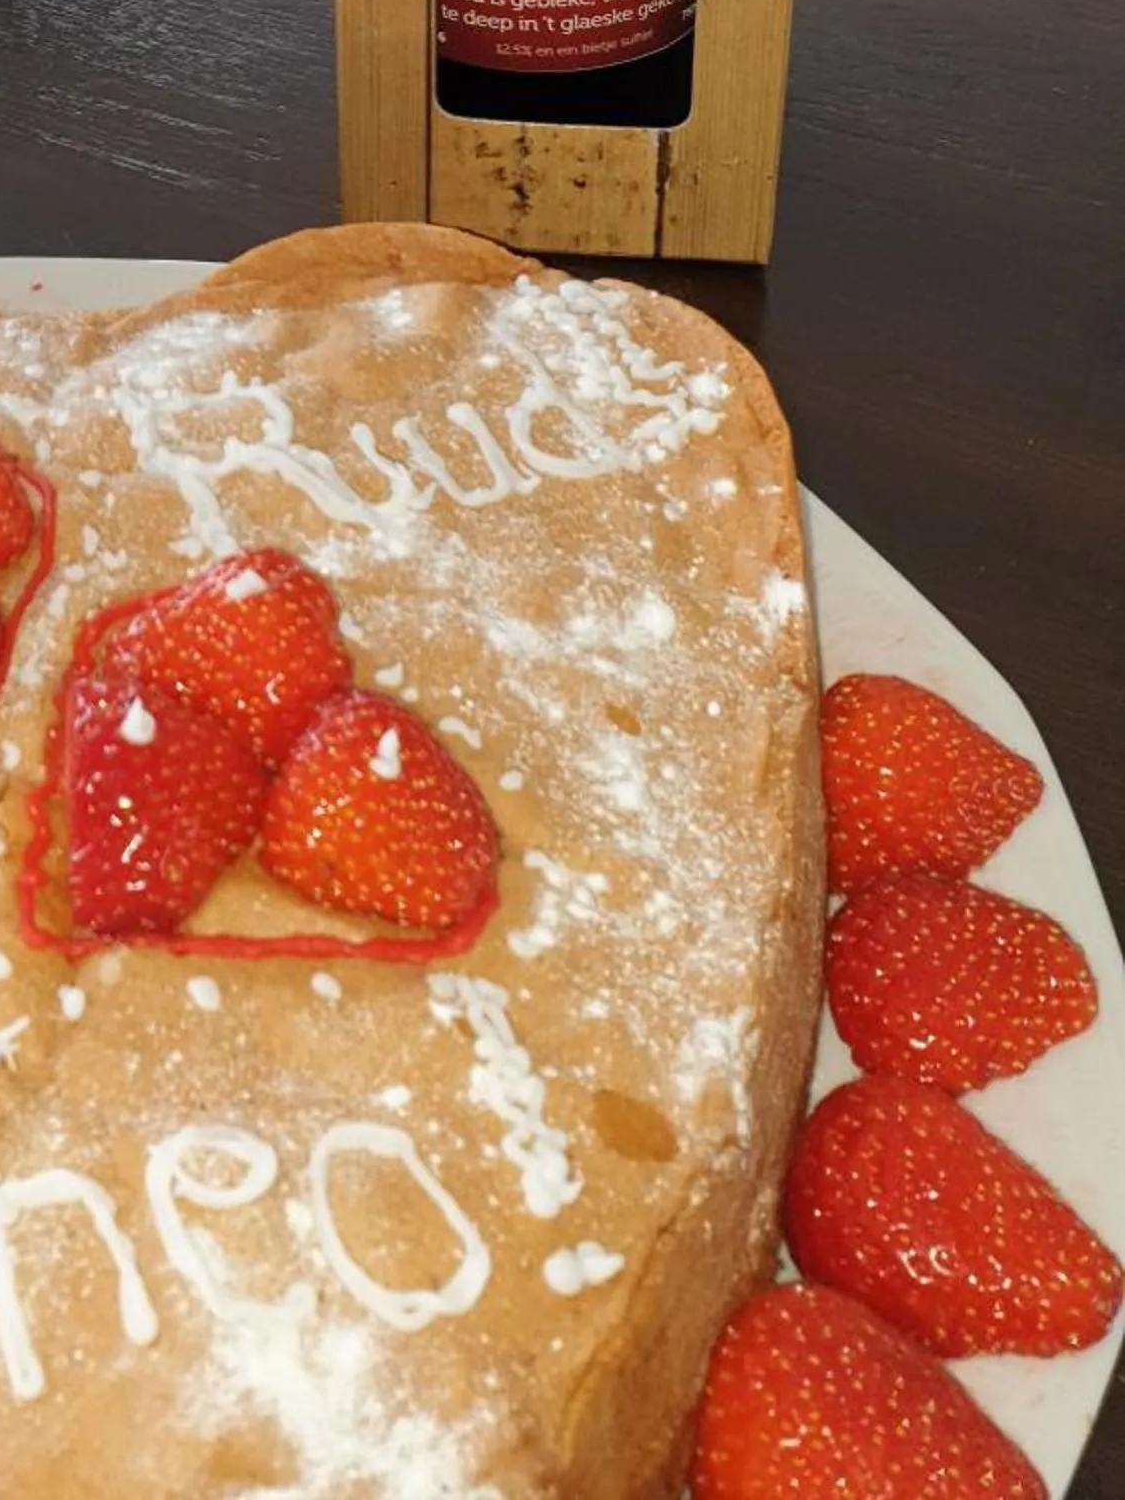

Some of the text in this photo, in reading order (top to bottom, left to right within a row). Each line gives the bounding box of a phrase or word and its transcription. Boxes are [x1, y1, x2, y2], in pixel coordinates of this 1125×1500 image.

[441, 4, 460, 21] te
[462, 9, 514, 33] deep
[518, 16, 539, 32] in
[560, 8, 634, 35] glaeske
